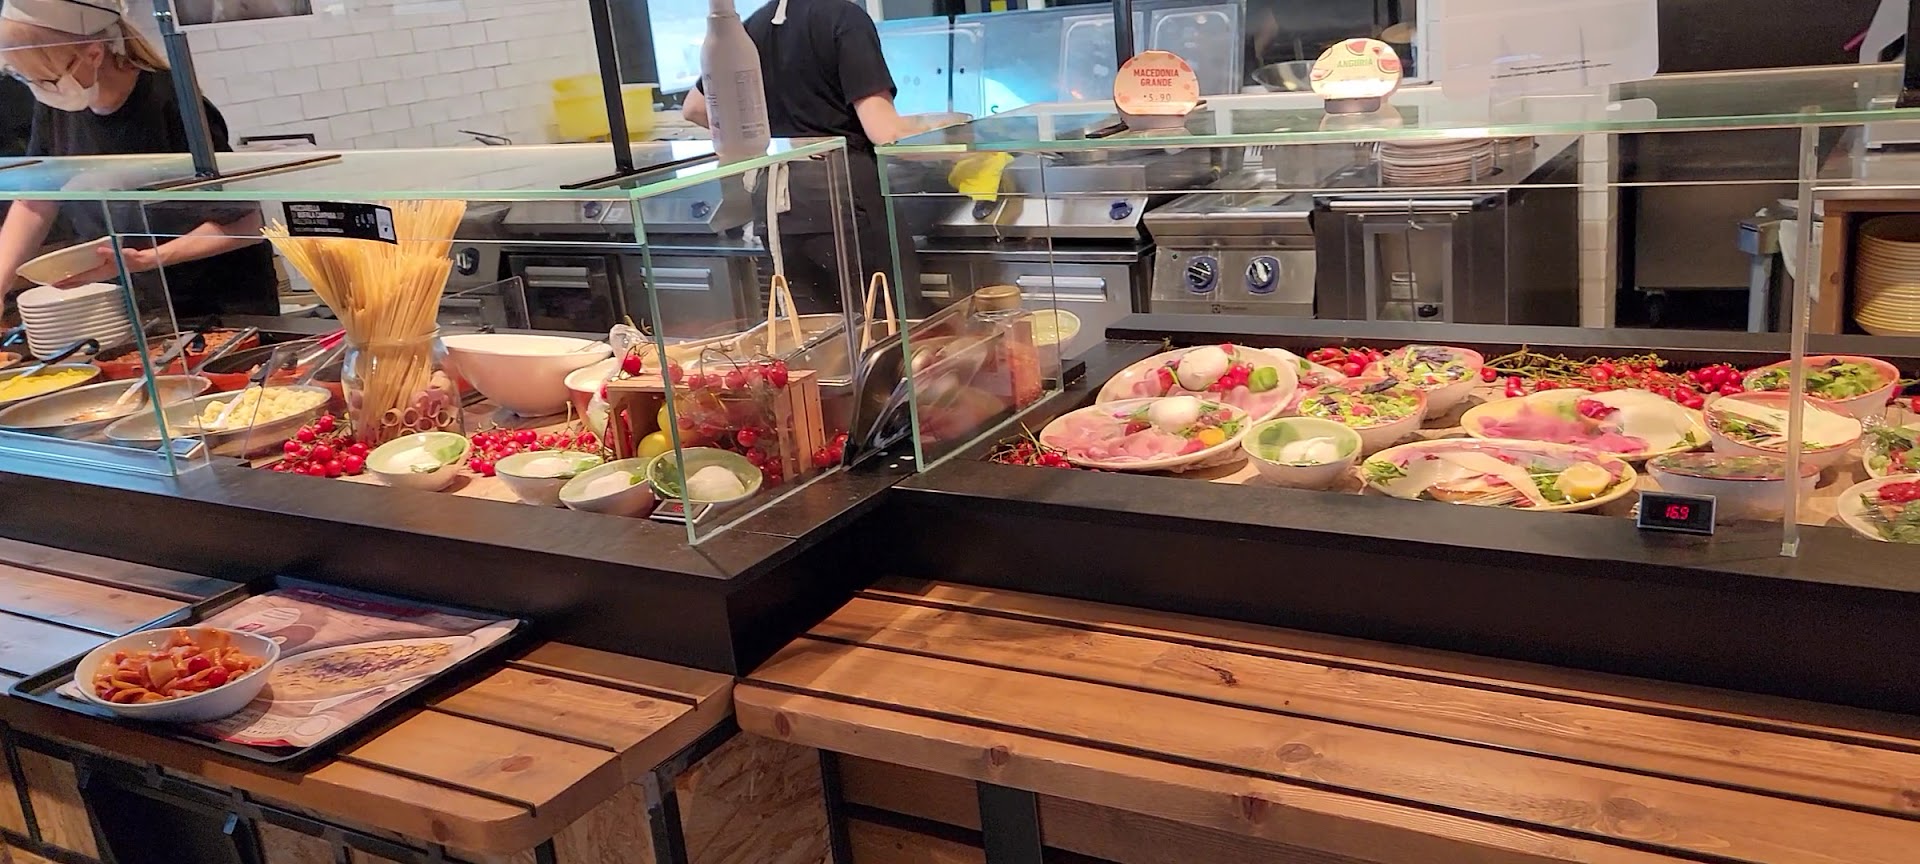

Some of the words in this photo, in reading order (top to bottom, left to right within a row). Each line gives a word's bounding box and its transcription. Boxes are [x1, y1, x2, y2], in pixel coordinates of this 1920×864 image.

[1337, 56, 1373, 68] ANGURIA
[1133, 68, 1179, 77] MACEDONIA
[1140, 78, 1172, 87] GRANDE
